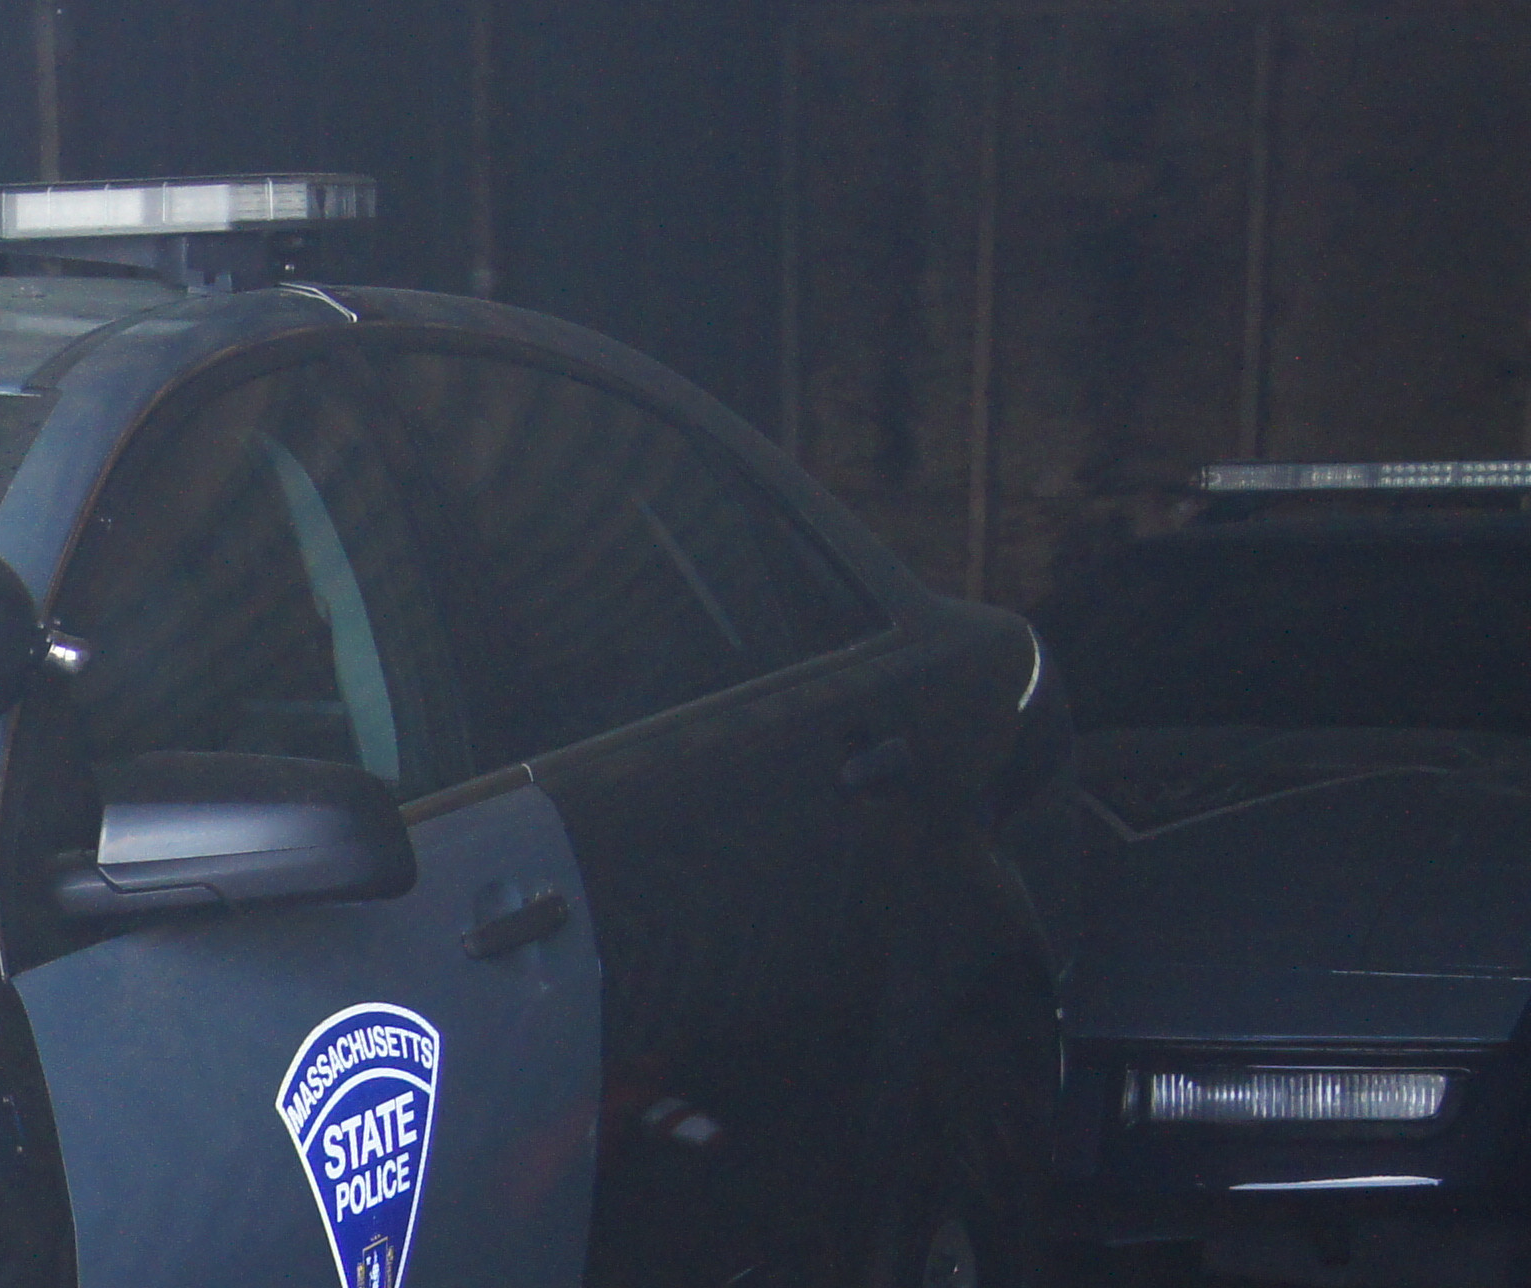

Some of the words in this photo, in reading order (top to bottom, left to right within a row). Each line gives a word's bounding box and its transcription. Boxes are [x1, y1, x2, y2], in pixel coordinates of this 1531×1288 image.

[288, 1025, 435, 1134] MASSACHUSETTS
[322, 1090, 417, 1181] STATE
[335, 1153, 411, 1223] POLICE
